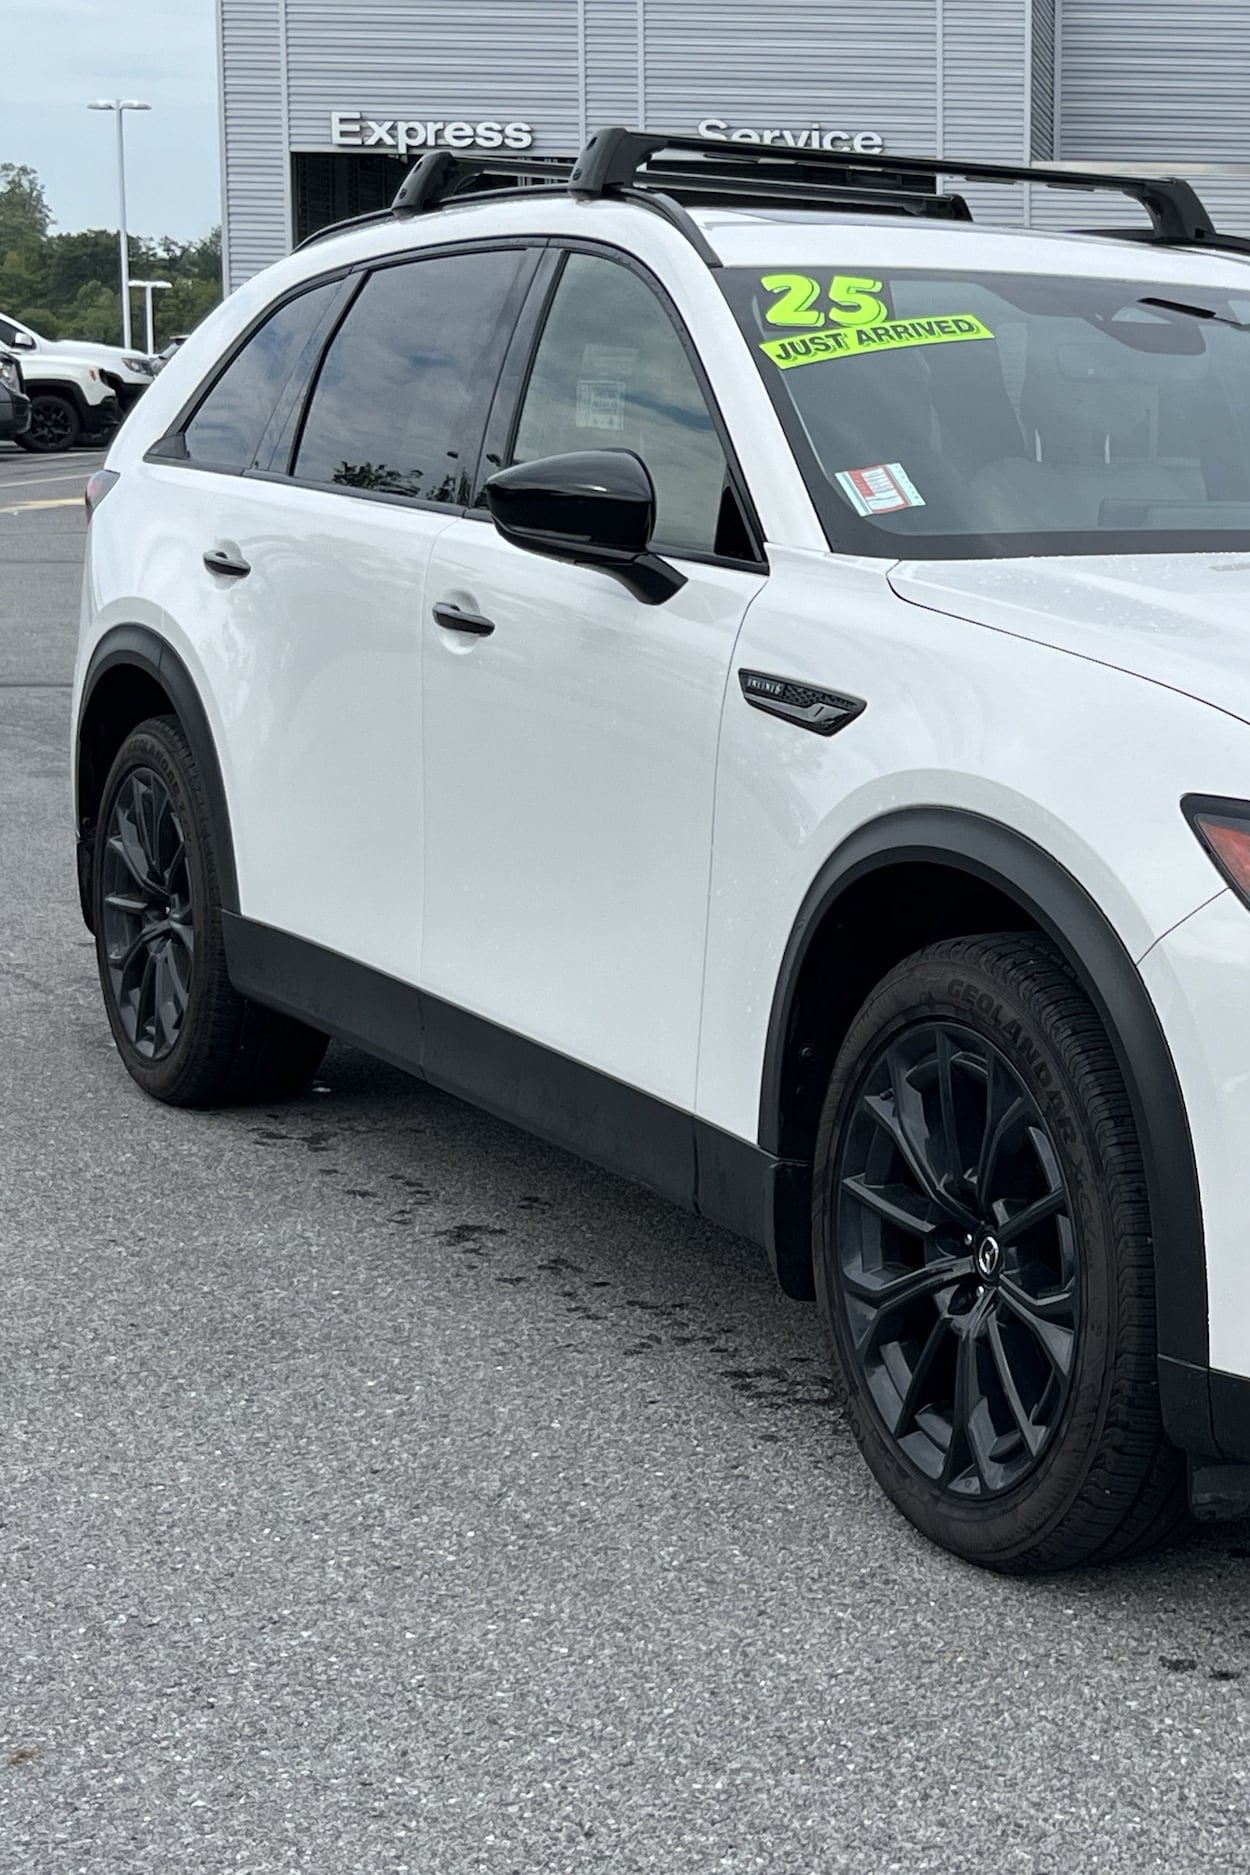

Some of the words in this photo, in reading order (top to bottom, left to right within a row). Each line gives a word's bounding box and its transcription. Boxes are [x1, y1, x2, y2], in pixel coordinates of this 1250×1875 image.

[330, 111, 533, 154] Express
[697, 119, 884, 154] Service
[761, 274, 888, 327] 25
[775, 332, 849, 362] JUST
[857, 318, 981, 347] ARRIVED
[948, 979, 1078, 1146] GEOLANDAR
